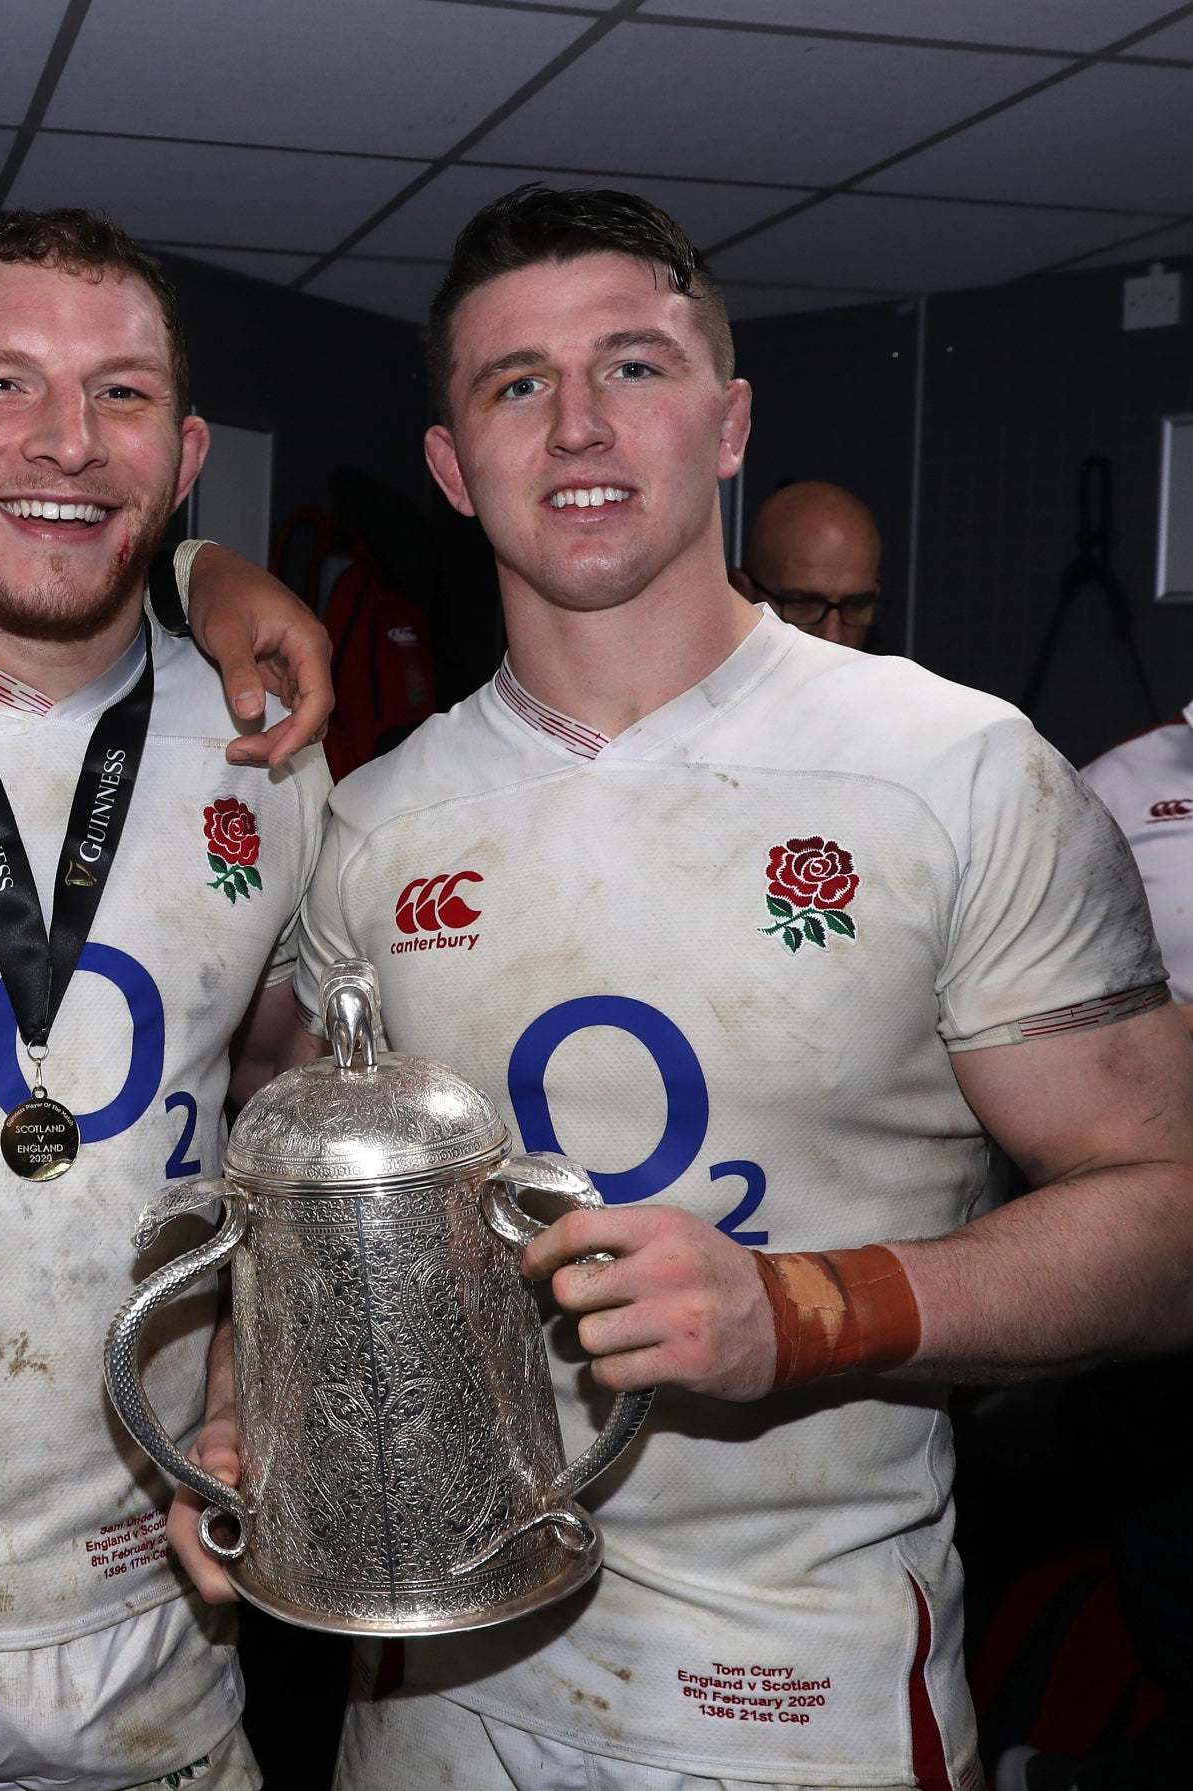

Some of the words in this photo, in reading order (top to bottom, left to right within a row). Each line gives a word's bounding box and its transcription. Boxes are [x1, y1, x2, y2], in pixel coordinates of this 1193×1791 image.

[79, 748, 127, 864] GUINNESS
[390, 931, 481, 955] canterbury
[15, 1124, 66, 1134] SCOTLAND
[17, 1143, 64, 1153] ENGLAND
[29, 1153, 53, 1163] 2020
[85, 1532, 131, 1552] England
[91, 1554, 109, 1568] 8th
[111, 1540, 155, 1562] February
[104, 1563, 128, 1580] 1396
[130, 1554, 151, 1569] 17th
[677, 1669, 743, 1691] England
[747, 1682, 757, 1692] v
[761, 1677, 832, 1692] Scotland
[712, 1662, 746, 1677] Tom
[750, 1665, 794, 1680] Curry
[712, 1691, 783, 1710] February
[788, 1694, 826, 1708] 2020
[698, 1703, 735, 1719] 1386
[739, 1709, 774, 1723] 21st
[778, 1711, 810, 1726] Cap
